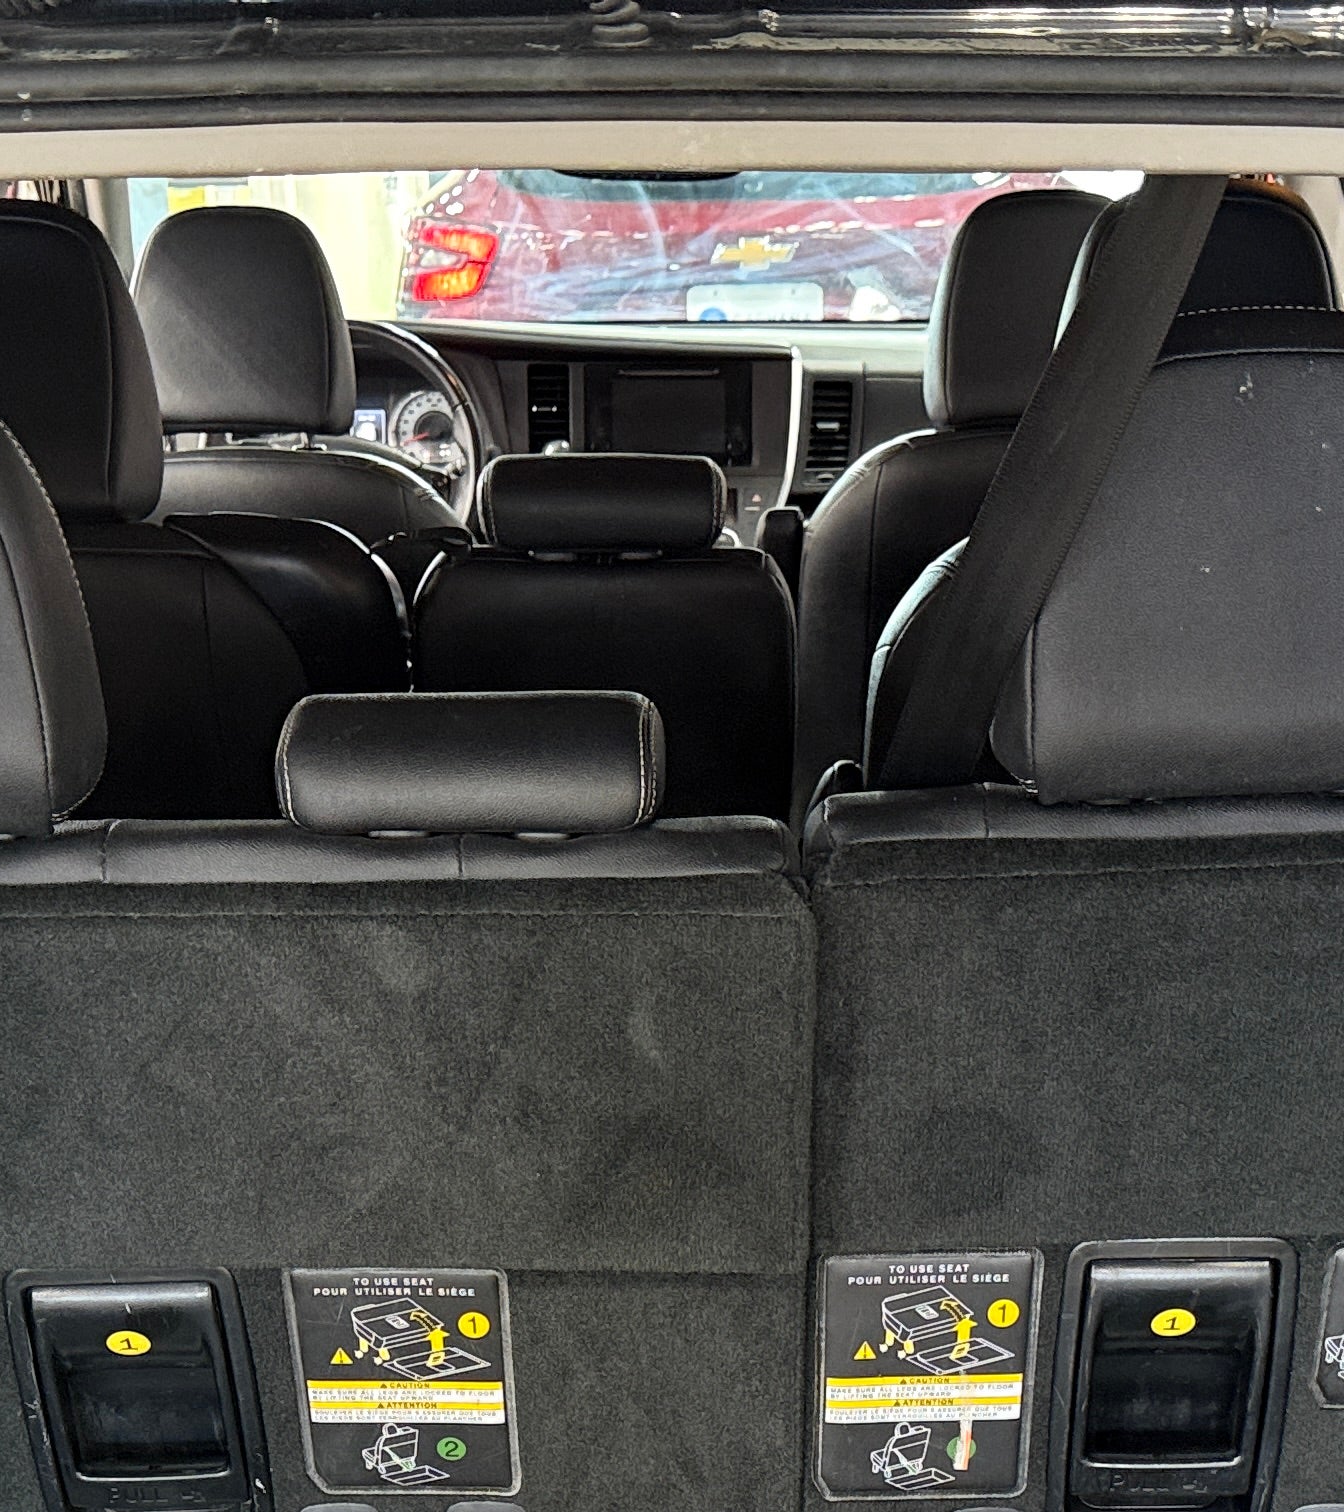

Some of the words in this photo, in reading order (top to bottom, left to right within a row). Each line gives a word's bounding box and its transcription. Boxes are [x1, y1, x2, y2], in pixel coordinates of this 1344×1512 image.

[889, 1264, 905, 1273] TO
[910, 1264, 933, 1273] USE
[939, 1263, 970, 1273] SEAT
[353, 1277, 369, 1286] TO
[374, 1277, 398, 1286] USE
[403, 1277, 435, 1286] SEAT
[847, 1276, 882, 1285] POUR
[889, 1275, 946, 1285] UTILISER
[952, 1275, 968, 1284] LE
[313, 1287, 348, 1297] POUR
[354, 1287, 412, 1297] UTILISER
[418, 1287, 434, 1296] LE
[444, 1440, 460, 1459] 2
